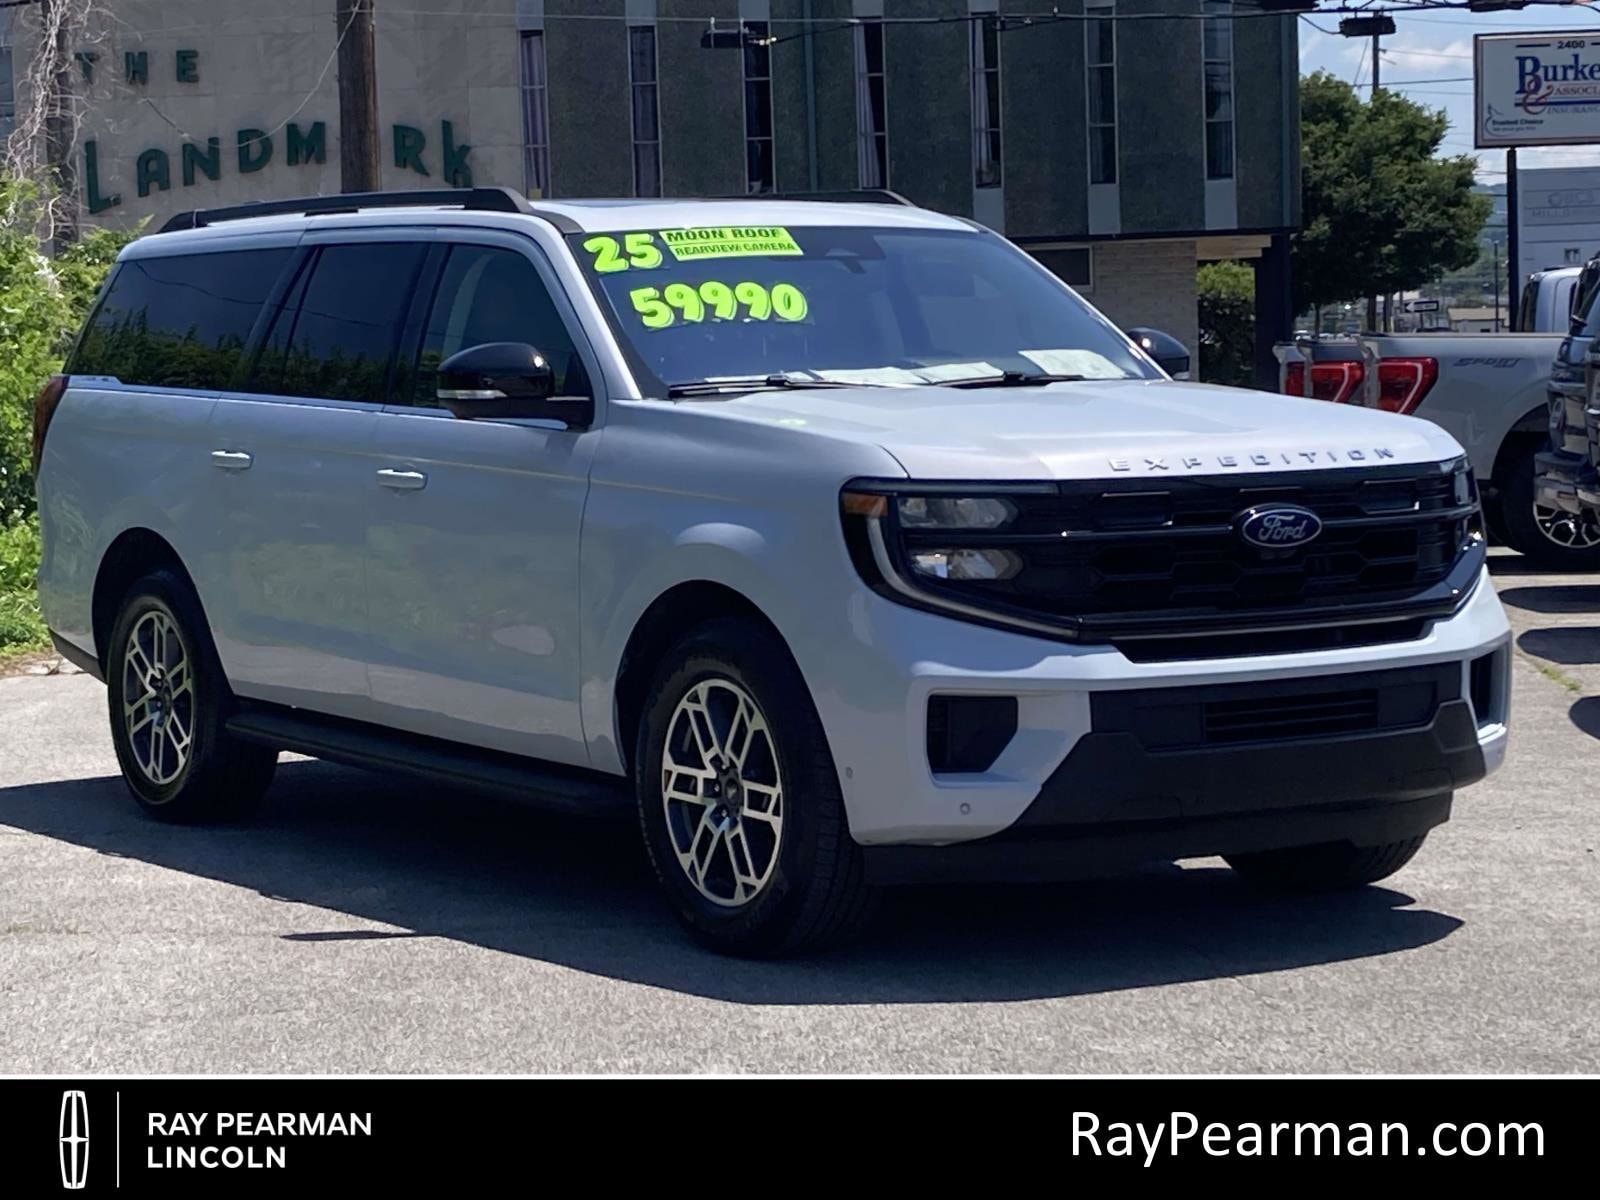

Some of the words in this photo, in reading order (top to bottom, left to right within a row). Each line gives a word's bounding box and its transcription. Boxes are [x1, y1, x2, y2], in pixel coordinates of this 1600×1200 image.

[1557, 41, 1585, 49] 2400
[75, 50, 199, 85] THE
[1555, 86, 1600, 96] ASSOCI
[84, 119, 472, 214] LANDMRK
[666, 229, 724, 242] MOON
[731, 227, 780, 239] ROOF
[583, 233, 663, 273] 25
[675, 244, 738, 256] REARVIEW
[743, 242, 796, 252] CAMERA
[630, 281, 808, 328] 59990
[1109, 448, 1395, 472] EXPEDITION
[1258, 514, 1307, 541] Ford
